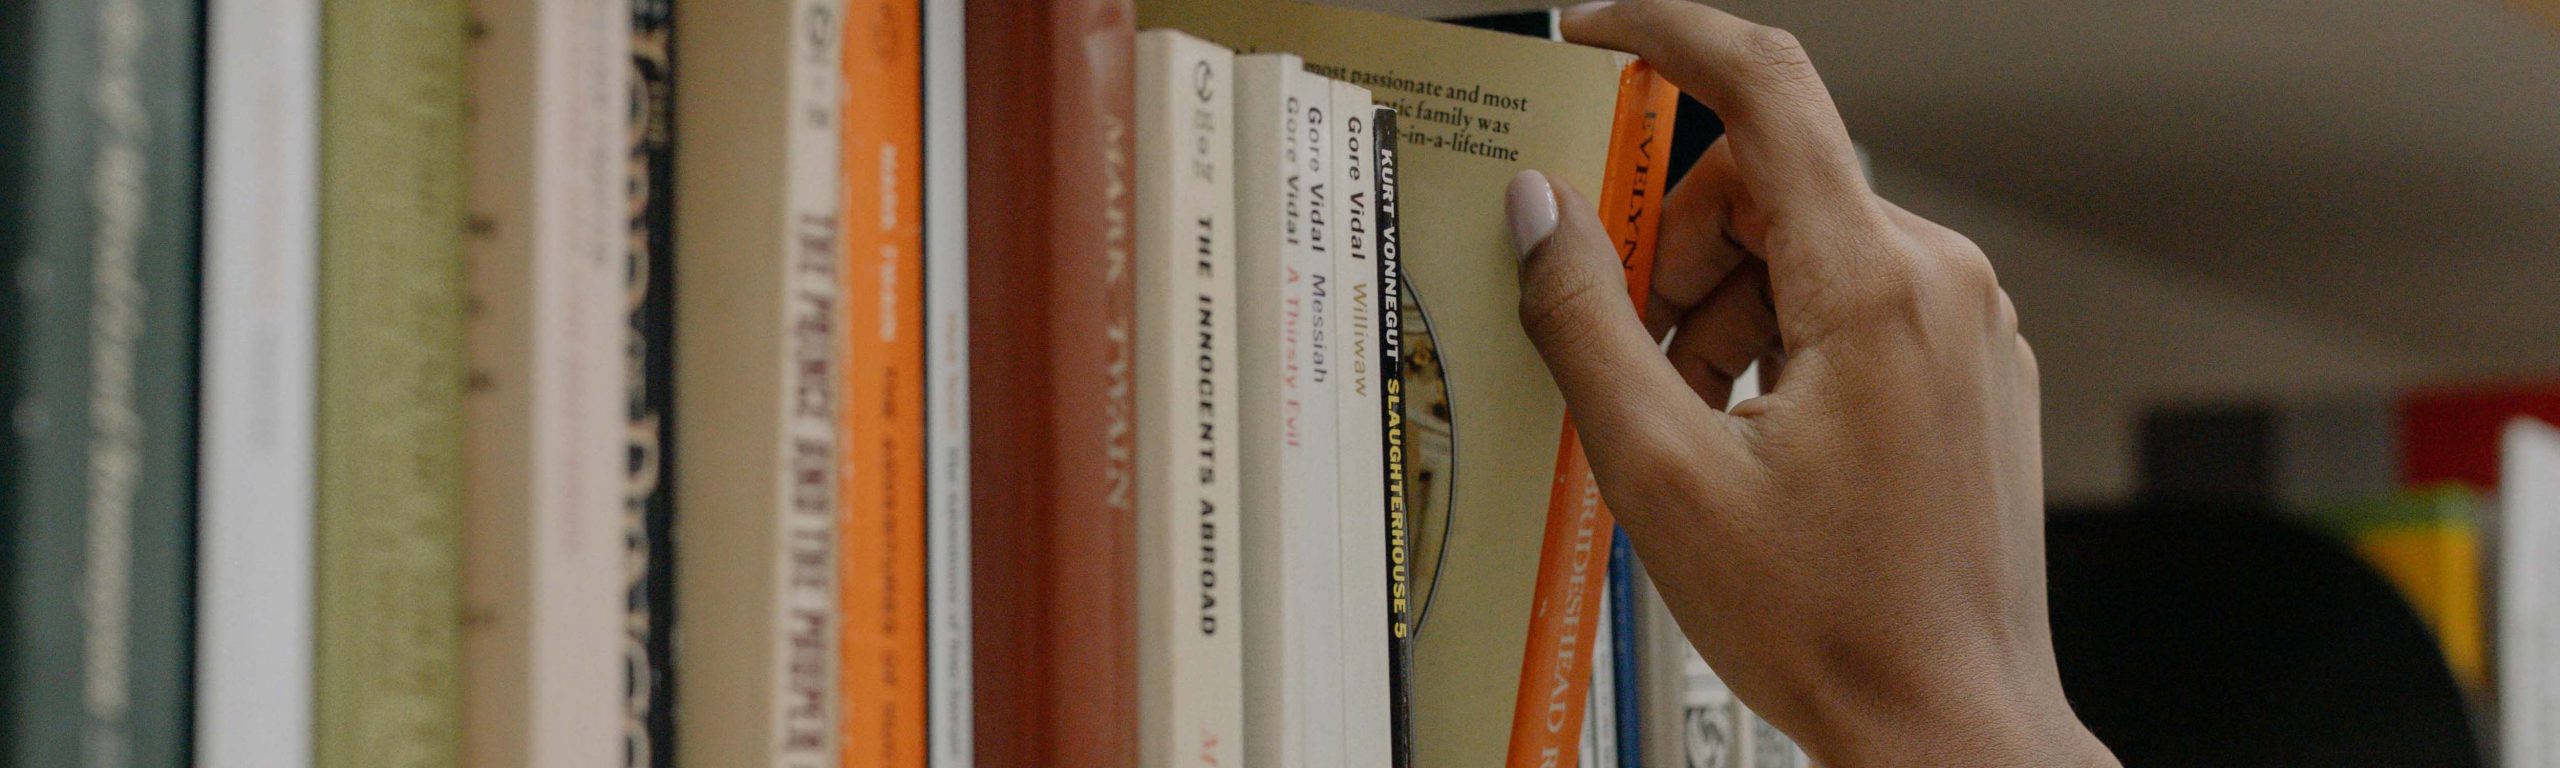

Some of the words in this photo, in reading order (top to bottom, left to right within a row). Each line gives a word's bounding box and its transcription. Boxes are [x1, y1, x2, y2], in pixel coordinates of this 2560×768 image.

[1303, 62, 1346, 80] most
[1350, 69, 1443, 97] passionate
[1445, 84, 1480, 103] and
[1482, 93, 1528, 112] most
[1416, 100, 1473, 132] family
[1478, 116, 1510, 134] was
[1286, 97, 1299, 163] Gore
[1308, 107, 1322, 173] Gore
[1348, 116, 1362, 181] Gore
[1397, 125, 1519, 162] -in-a-lifetime
[1103, 114, 1127, 284] MARK
[1286, 175, 1299, 245] Vidal
[1310, 183, 1326, 252] Vidal
[1381, 149, 1396, 218] KURT
[1622, 111, 1656, 272] EVELYN
[1198, 217, 1213, 277] THE
[1350, 191, 1366, 261] Vidal
[1287, 265, 1299, 283] A
[1383, 226, 1399, 362] VONNEGUT
[1284, 298, 1299, 389] Thirsty
[1312, 274, 1327, 384] Messiah
[1352, 283, 1368, 398] Williwaw
[1105, 316, 1129, 509] TWAIN
[1199, 294, 1215, 485] INNOCENTS
[1287, 401, 1299, 447] Evil
[1387, 378, 1407, 614] SLAUGHTERHOUSE
[1201, 499, 1216, 636] ABROAD
[1546, 471, 1599, 734] BRIDESHEAD
[1393, 621, 1408, 640] 5
